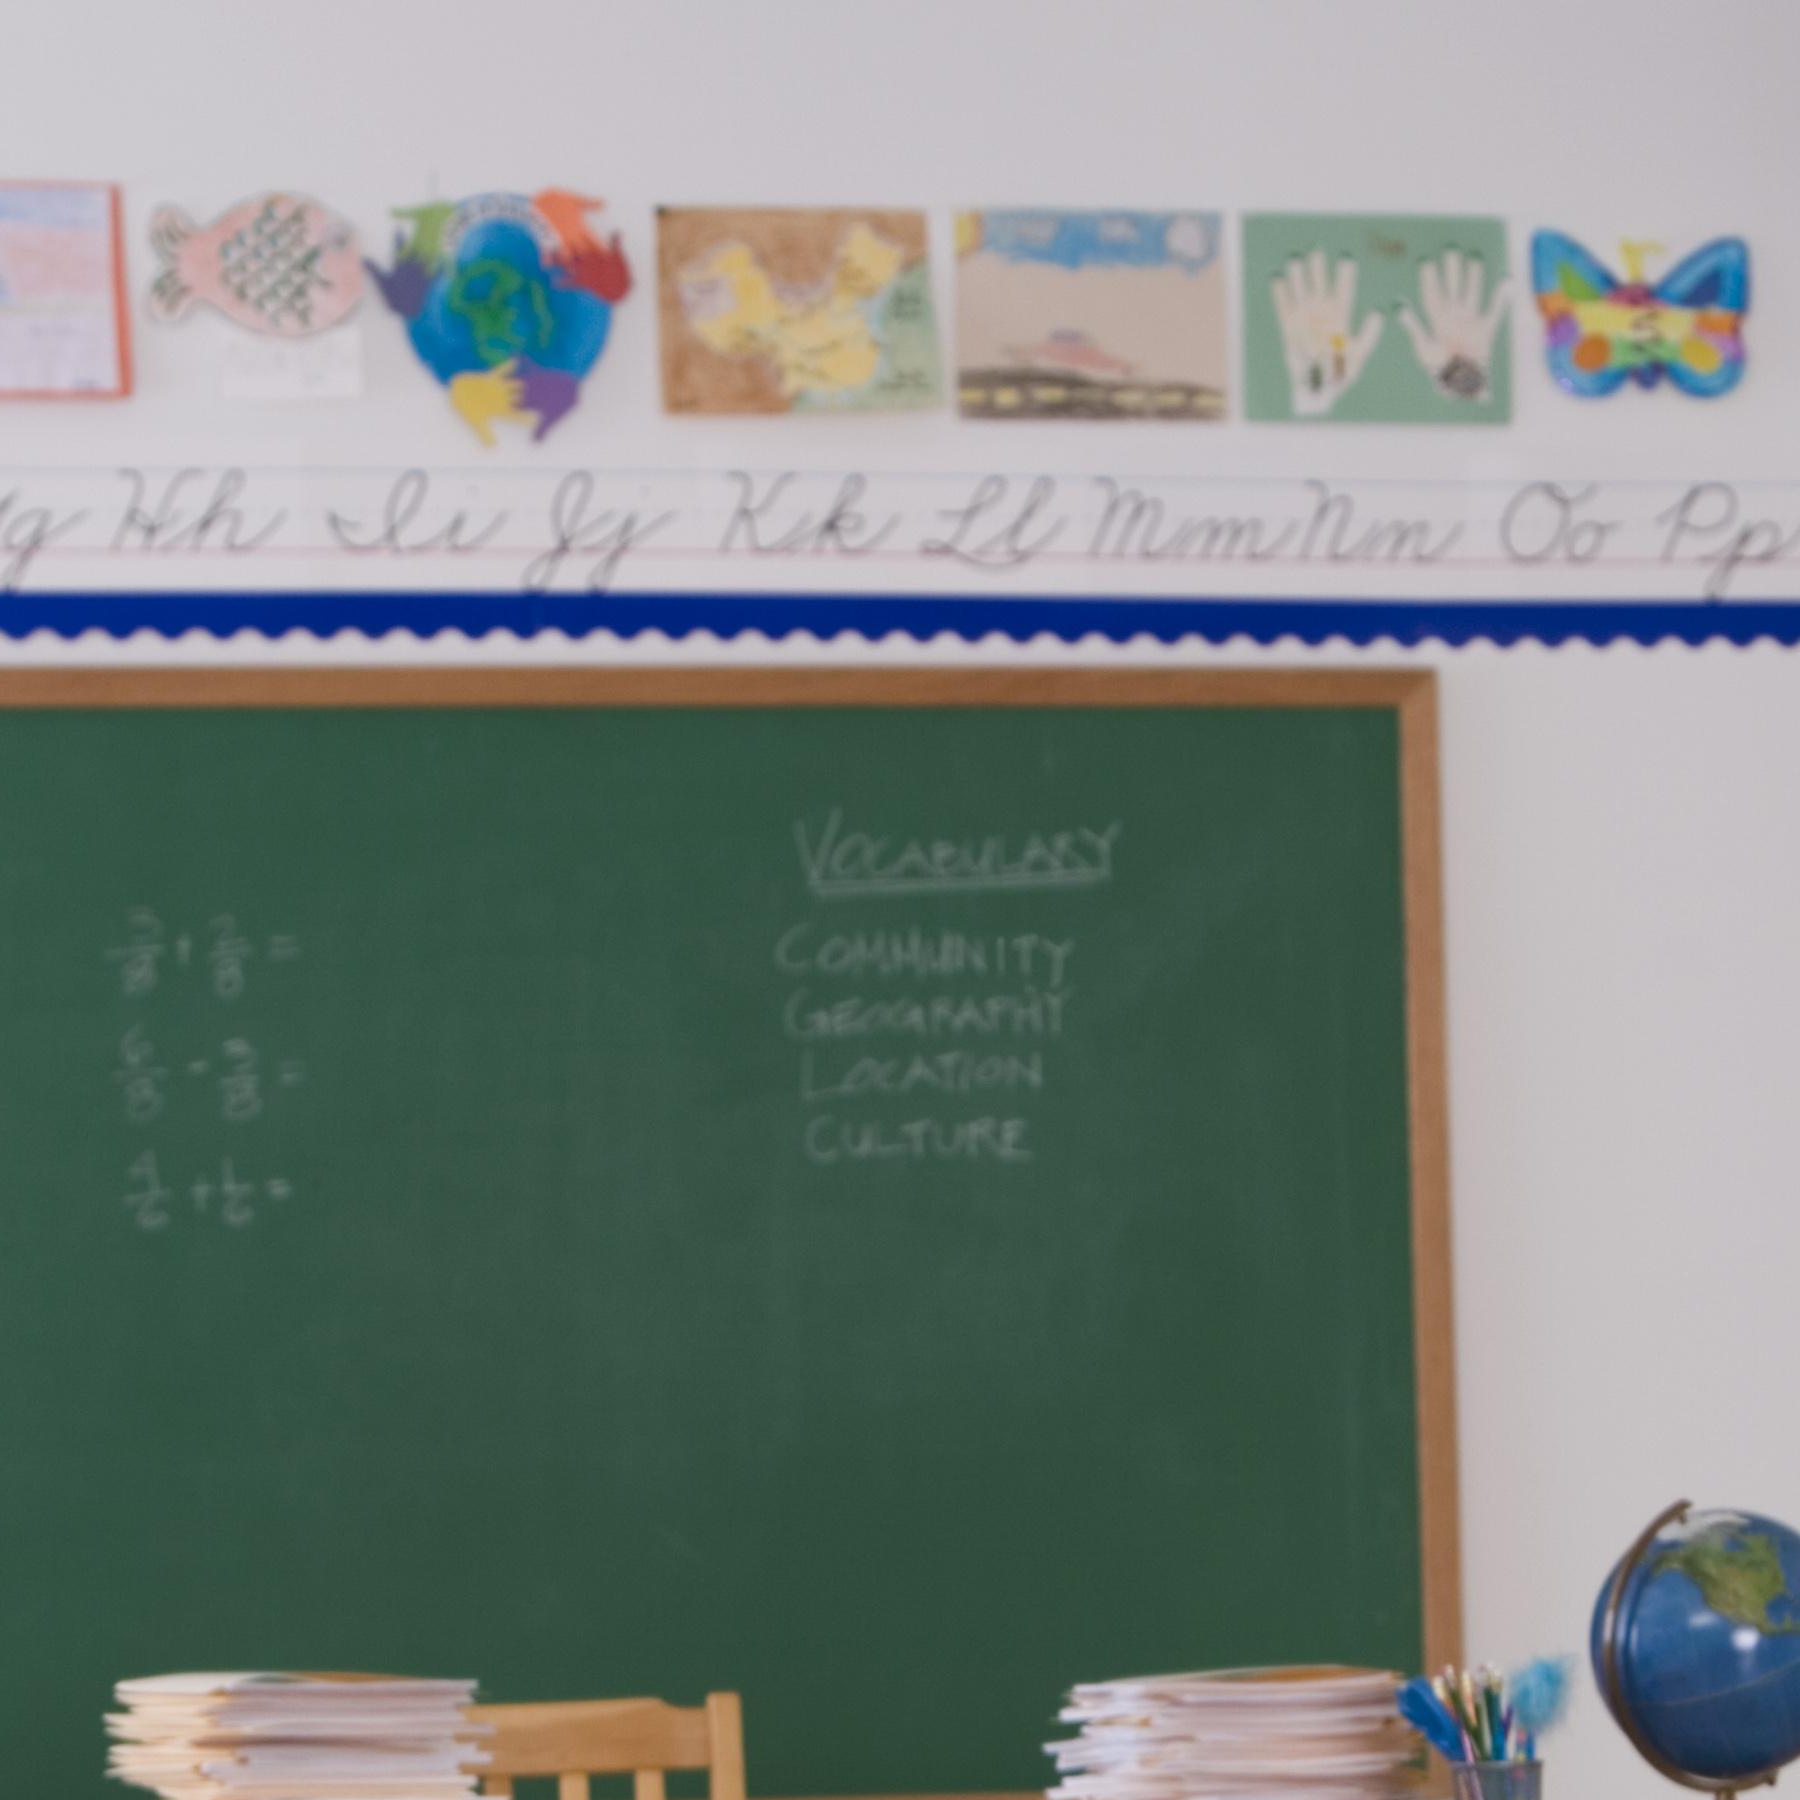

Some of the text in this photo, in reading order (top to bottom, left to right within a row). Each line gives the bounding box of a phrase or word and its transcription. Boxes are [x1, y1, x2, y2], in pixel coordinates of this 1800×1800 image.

[107, 467, 289, 555] Hh
[326, 469, 509, 555] Ii
[521, 469, 675, 597] Jj
[718, 469, 900, 555] Kk
[919, 471, 1070, 574] Ll
[1085, 474, 1302, 565] Mm
[1295, 477, 1465, 565] Nn
[1498, 479, 1625, 565] Oo
[793, 806, 1122, 887] VOCABULARY
[773, 922, 1075, 989] COMMUNITY
[784, 986, 1076, 1039] GEOGRAPHY
[802, 1046, 1044, 1101] LOCATION
[805, 1114, 1033, 1164] CULTURE
